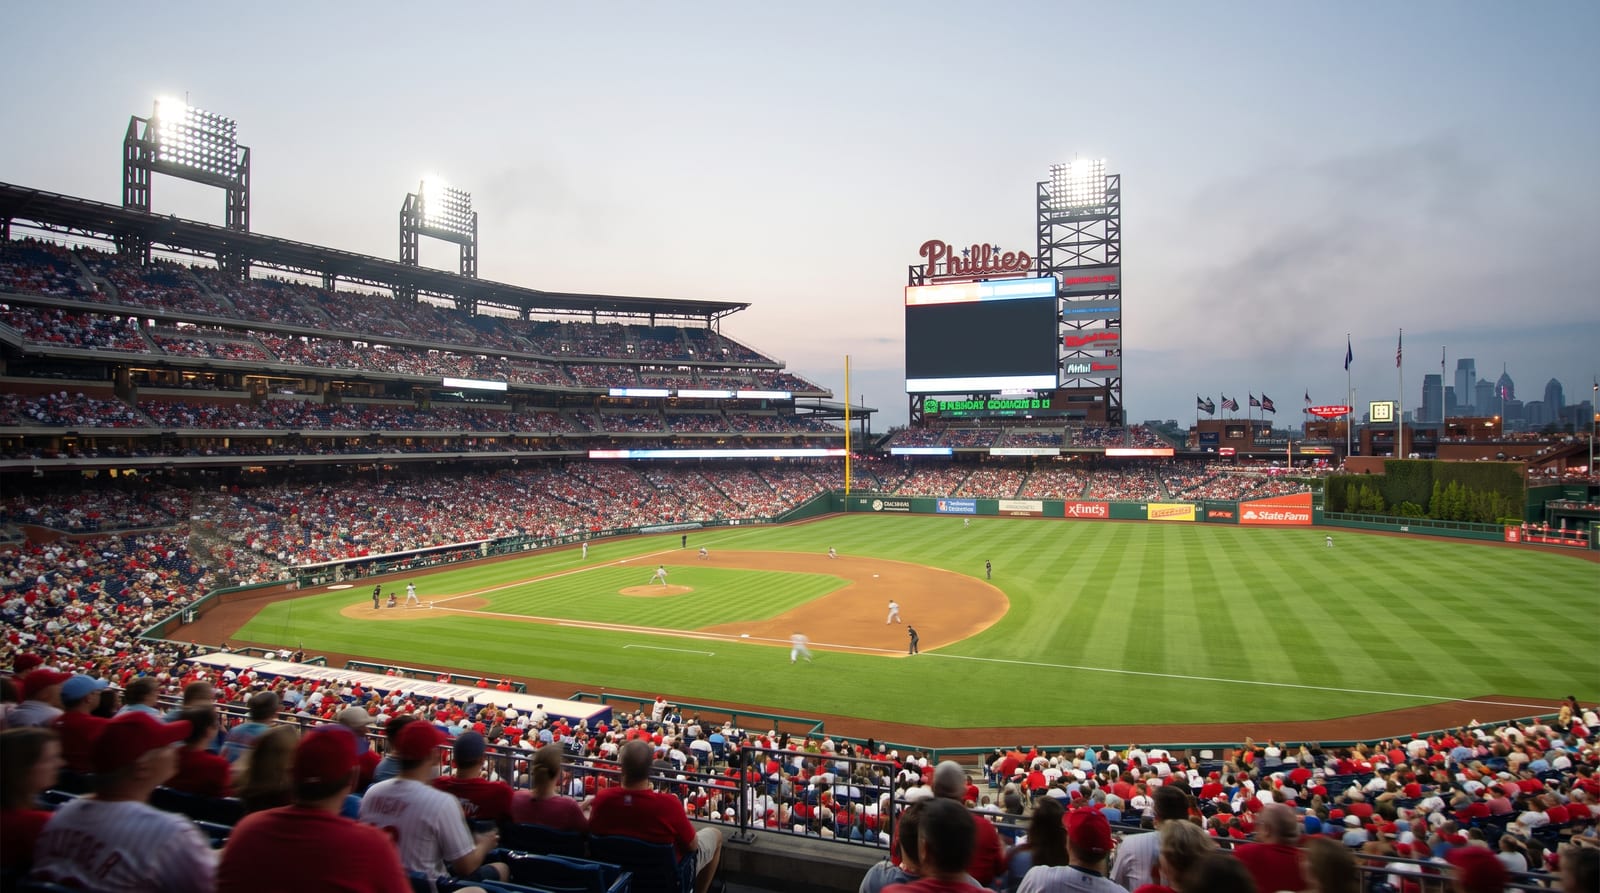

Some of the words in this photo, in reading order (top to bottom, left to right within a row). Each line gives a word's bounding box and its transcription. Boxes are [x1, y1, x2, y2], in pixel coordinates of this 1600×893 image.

[919, 239, 1033, 278] Phillies
[1258, 511, 1284, 521] State
[1284, 511, 1309, 521] Farm
